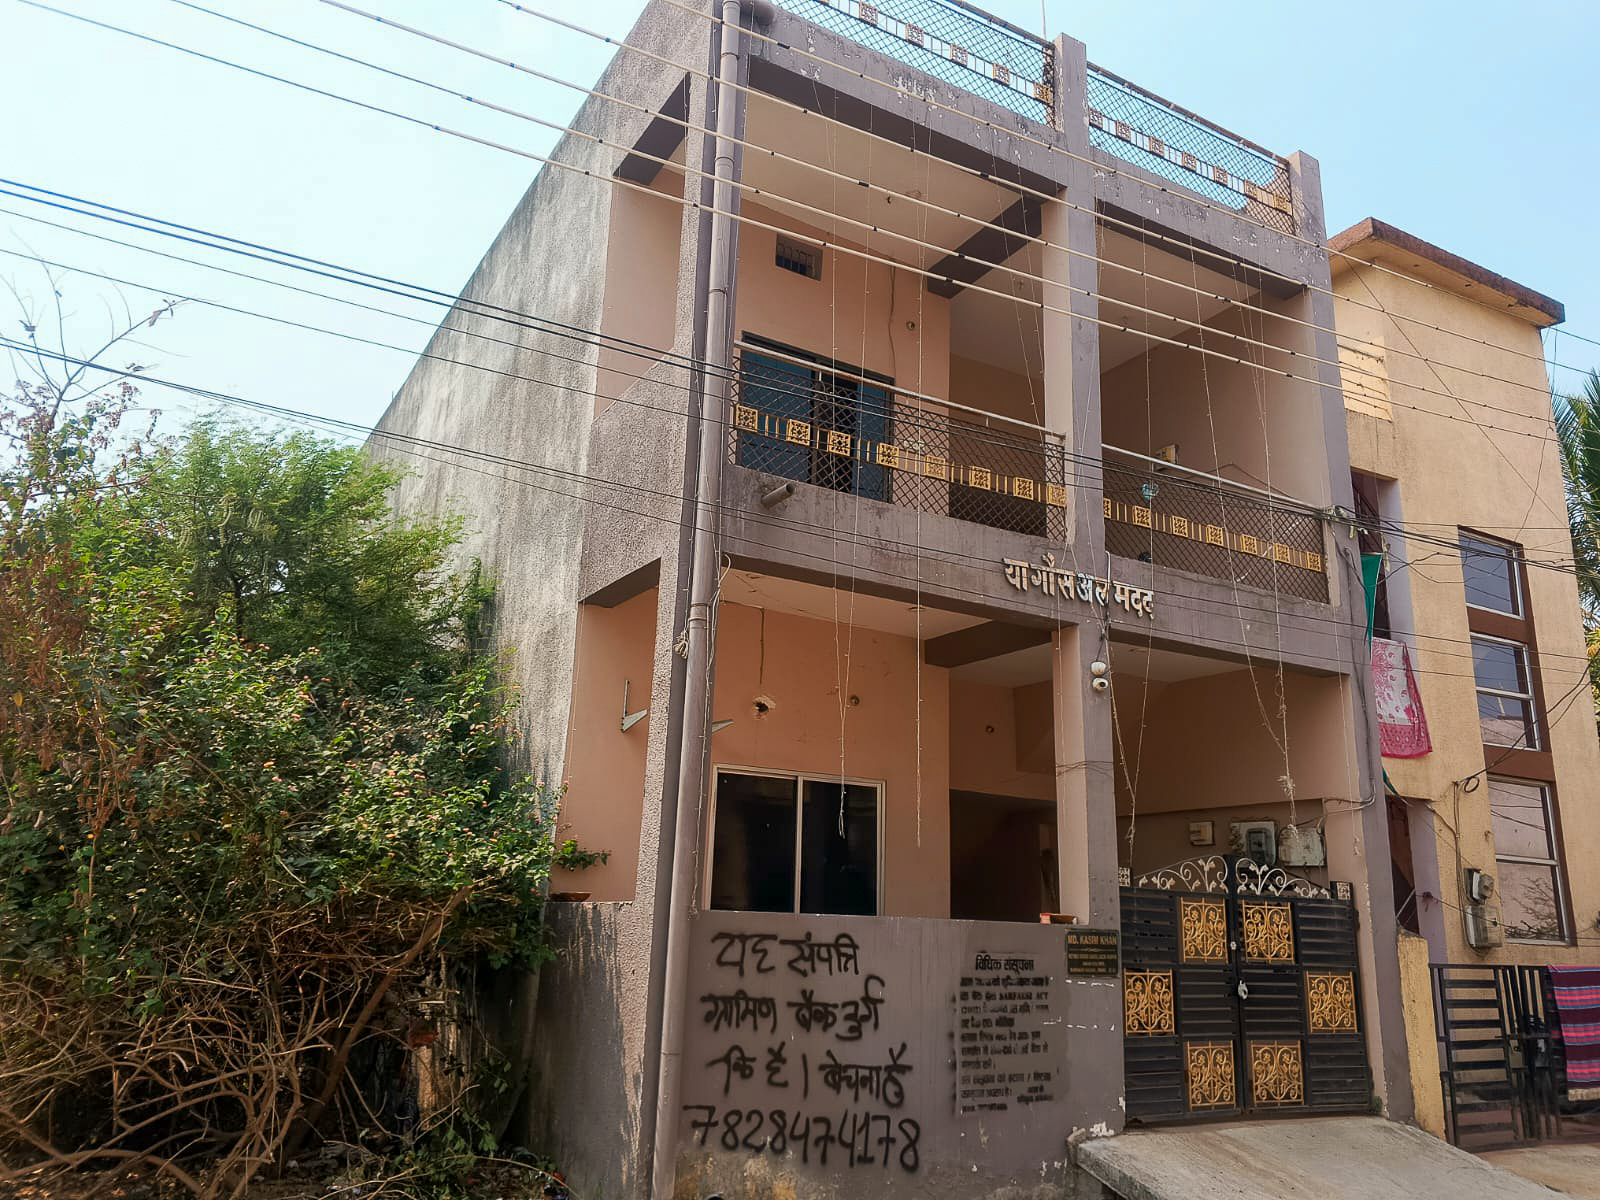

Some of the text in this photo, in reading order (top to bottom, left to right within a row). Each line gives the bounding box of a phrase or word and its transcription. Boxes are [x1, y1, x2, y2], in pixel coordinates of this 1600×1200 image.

[1002, 557, 1029, 592] या
[1112, 580, 1155, 620] मदद
[711, 931, 778, 977] यह
[682, 1104, 922, 1172] 7828474178
